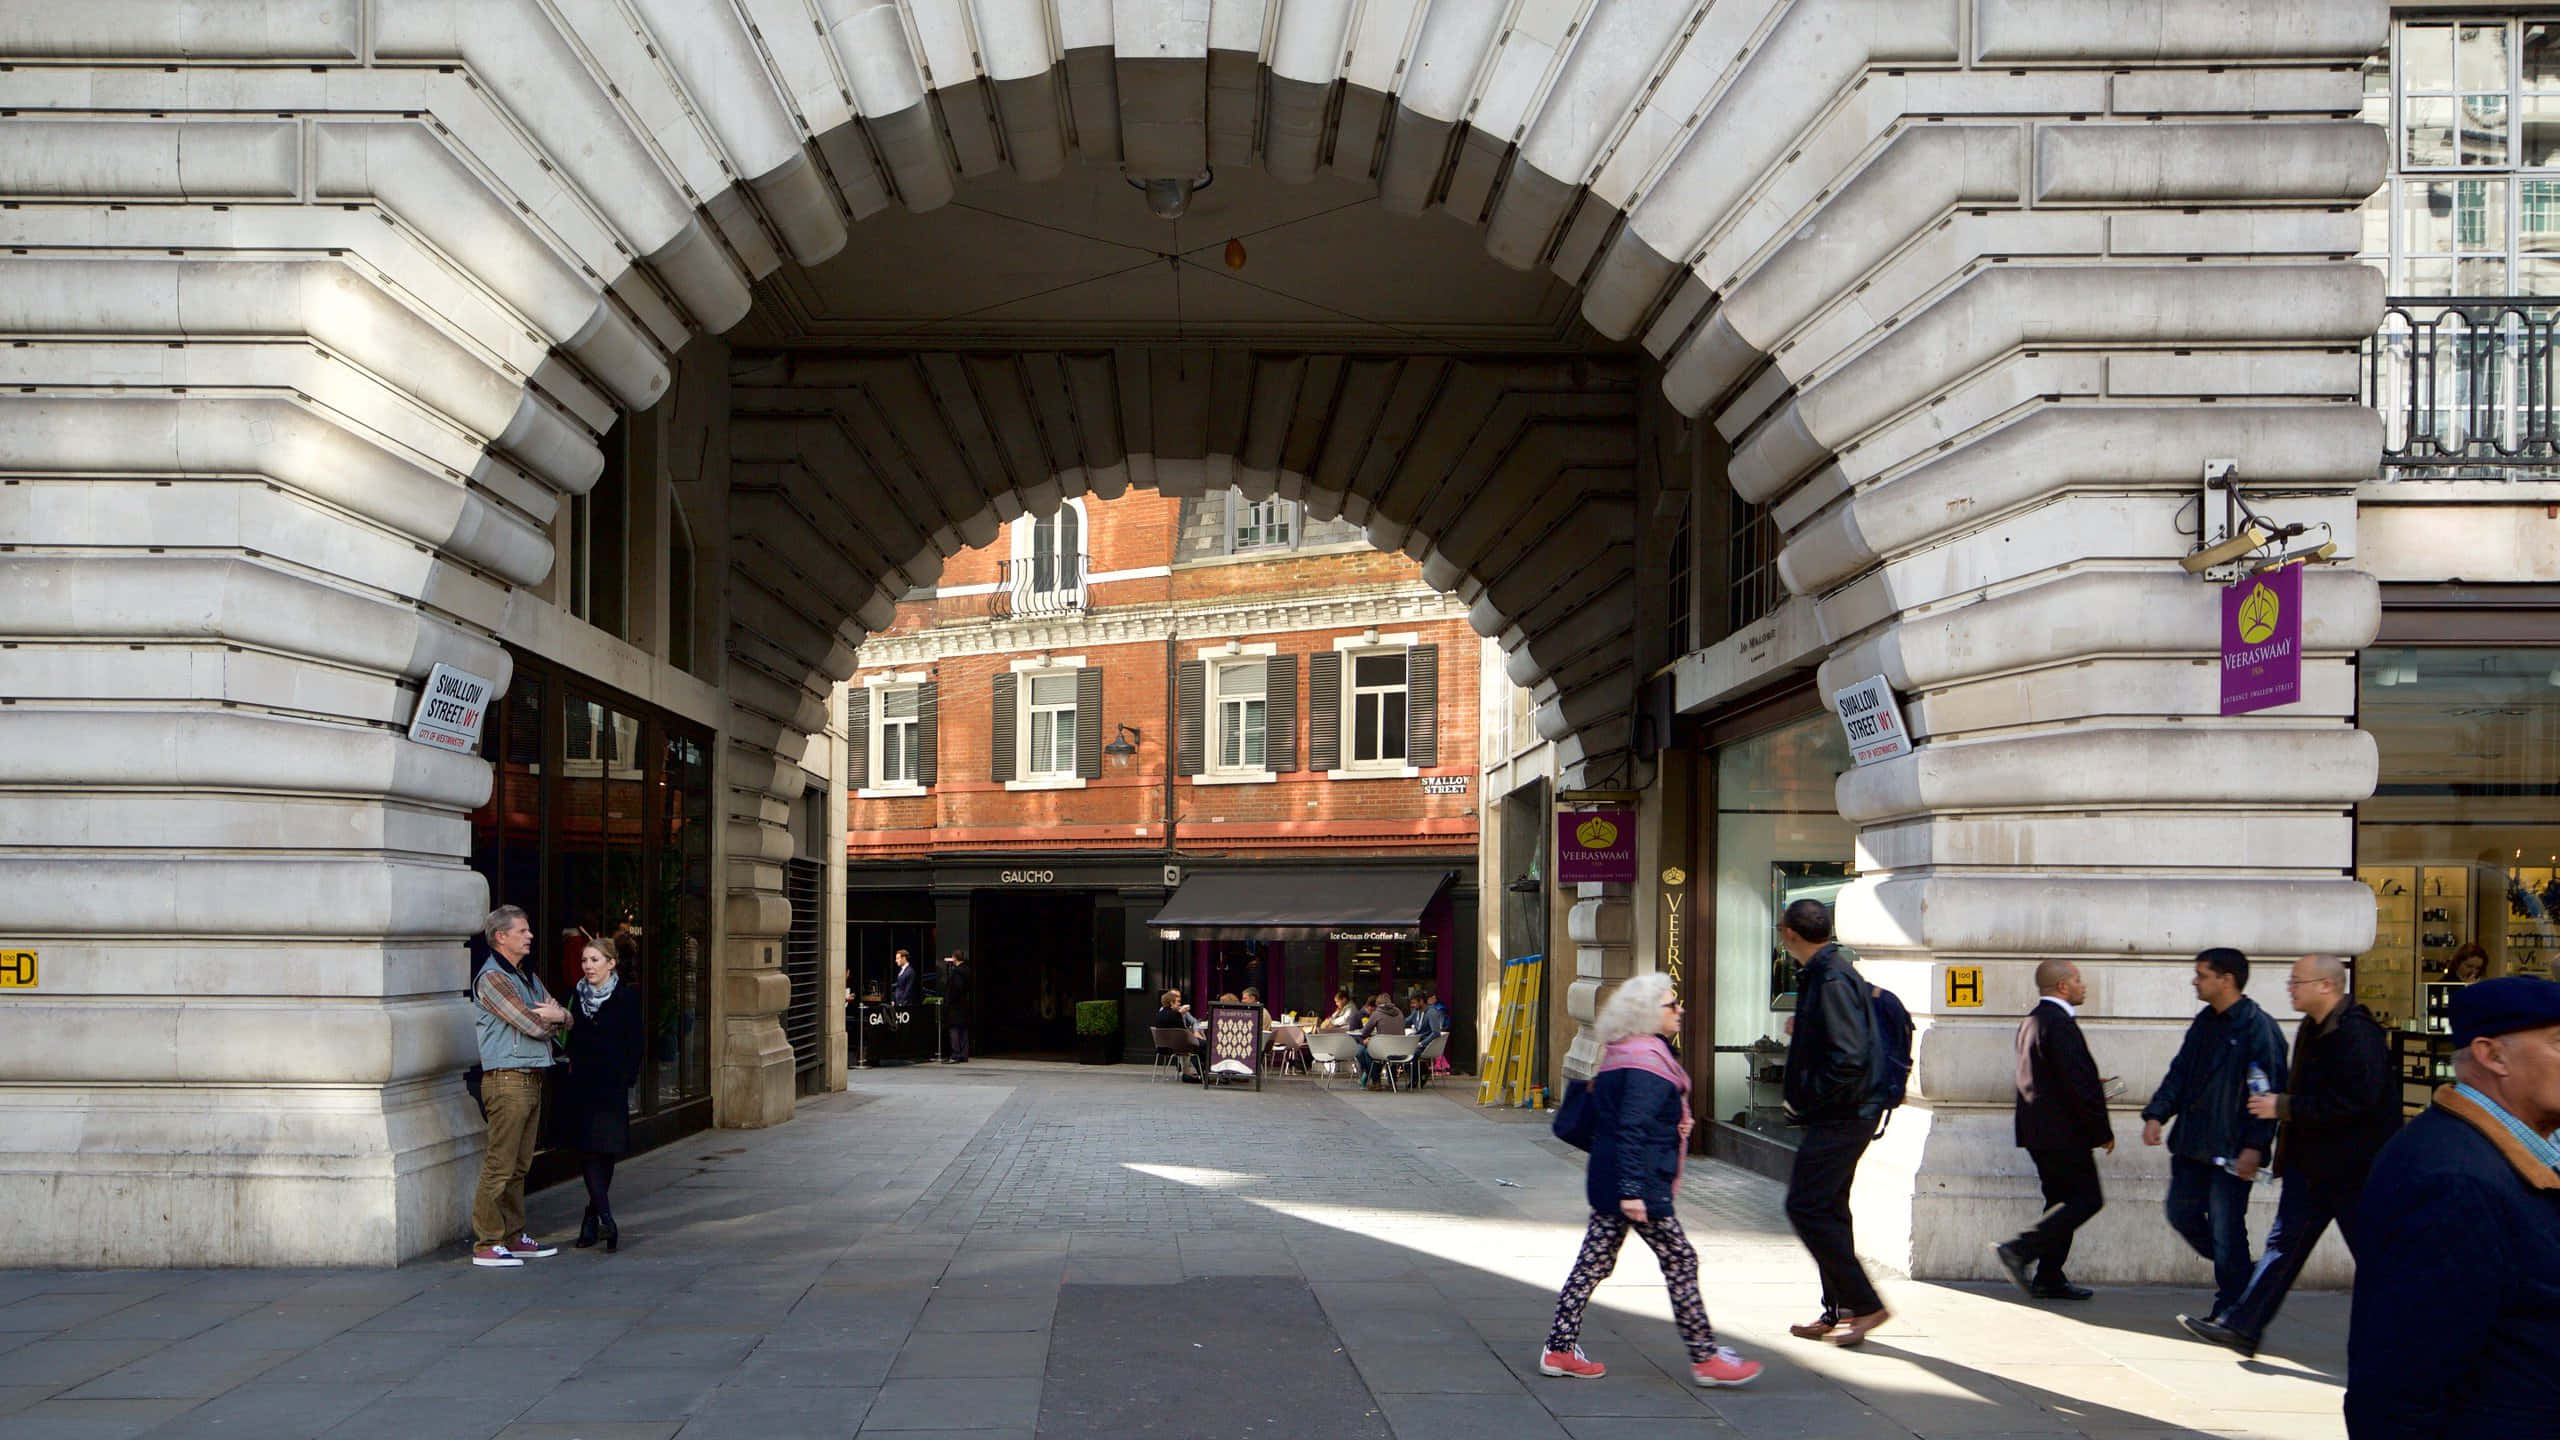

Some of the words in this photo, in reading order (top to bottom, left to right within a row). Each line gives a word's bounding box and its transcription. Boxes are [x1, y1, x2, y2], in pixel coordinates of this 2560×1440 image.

[2224, 638, 2292, 671] VEERASWAMY
[436, 674, 483, 705] SWALLOW
[1839, 687, 1880, 718] SWALLOW
[427, 698, 465, 725] STREET
[463, 708, 480, 729] W1
[1847, 715, 1879, 740] STREET
[1876, 710, 1894, 731] W1
[1421, 776, 1471, 785] SWALLOW
[1424, 785, 1466, 794] STREET
[1001, 870, 1054, 883] GAUCHO
[1330, 932, 1340, 940] Ice
[1341, 932, 1363, 940] Cream
[1364, 932, 1370, 940] &
[1370, 932, 1393, 940] Coffee
[1394, 932, 1407, 940] Bar
[1666, 893, 1684, 1049] VEERAS
[1952, 970, 1977, 1002] H
[869, 1011, 910, 1025] GAHO
